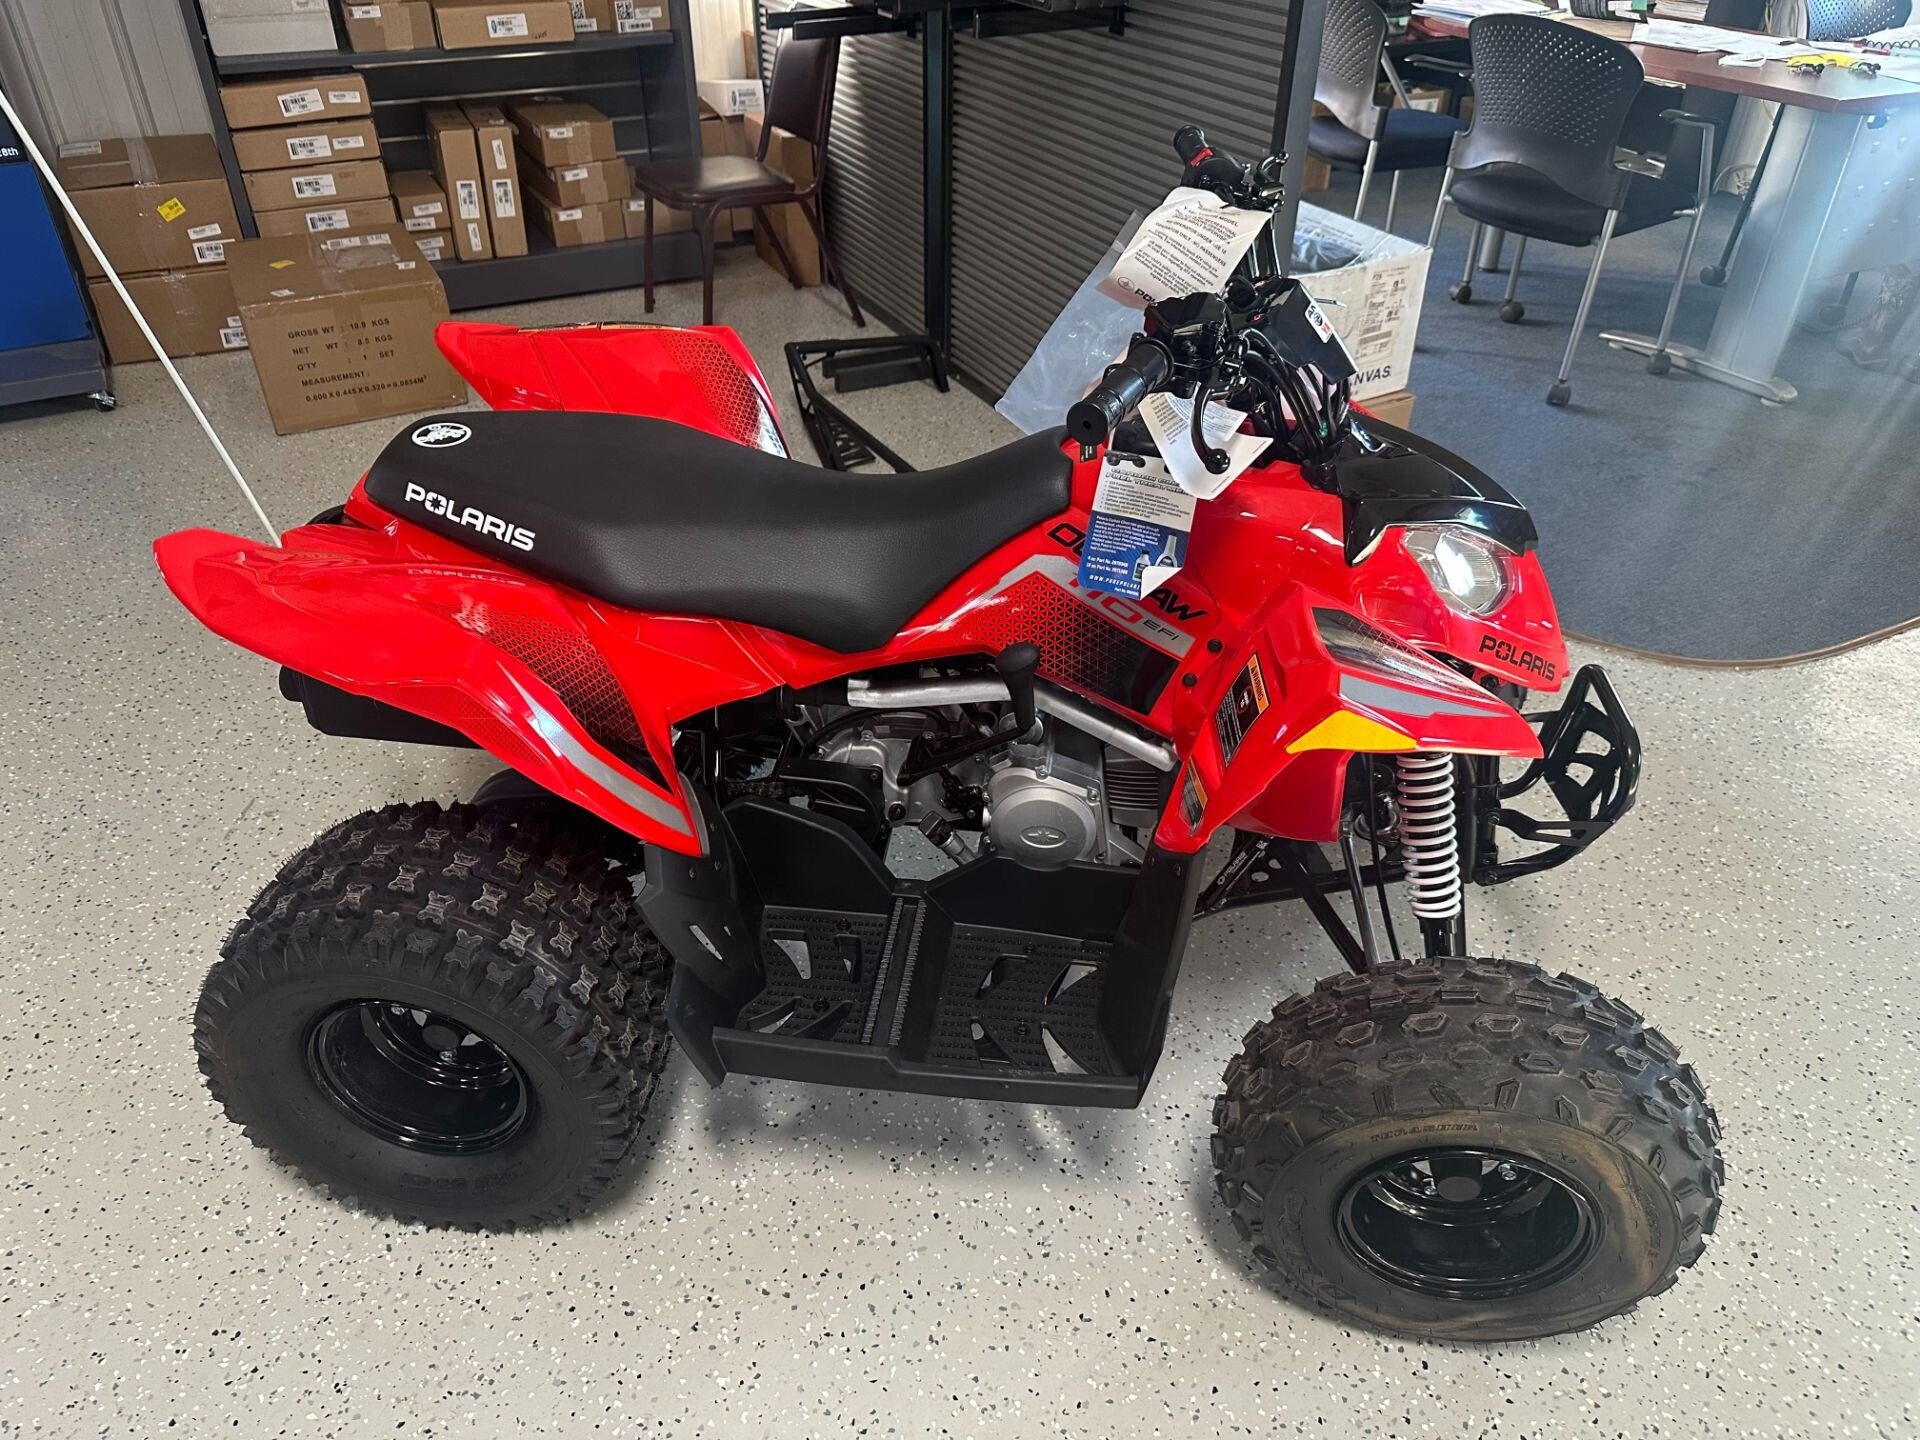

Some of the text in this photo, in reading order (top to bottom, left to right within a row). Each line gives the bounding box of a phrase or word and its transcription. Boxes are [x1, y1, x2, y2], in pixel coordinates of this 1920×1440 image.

[288, 328, 318, 339] GROSS
[322, 326, 335, 334] WT
[372, 318, 390, 327] KGS
[292, 347, 309, 355] NET
[326, 342, 338, 350] WT
[375, 334, 392, 343] KGS
[297, 362, 316, 371] Q'TY
[405, 482, 536, 552] POLARIS
[1143, 620, 1179, 640] EFI
[1479, 635, 1555, 681] POLARIS
